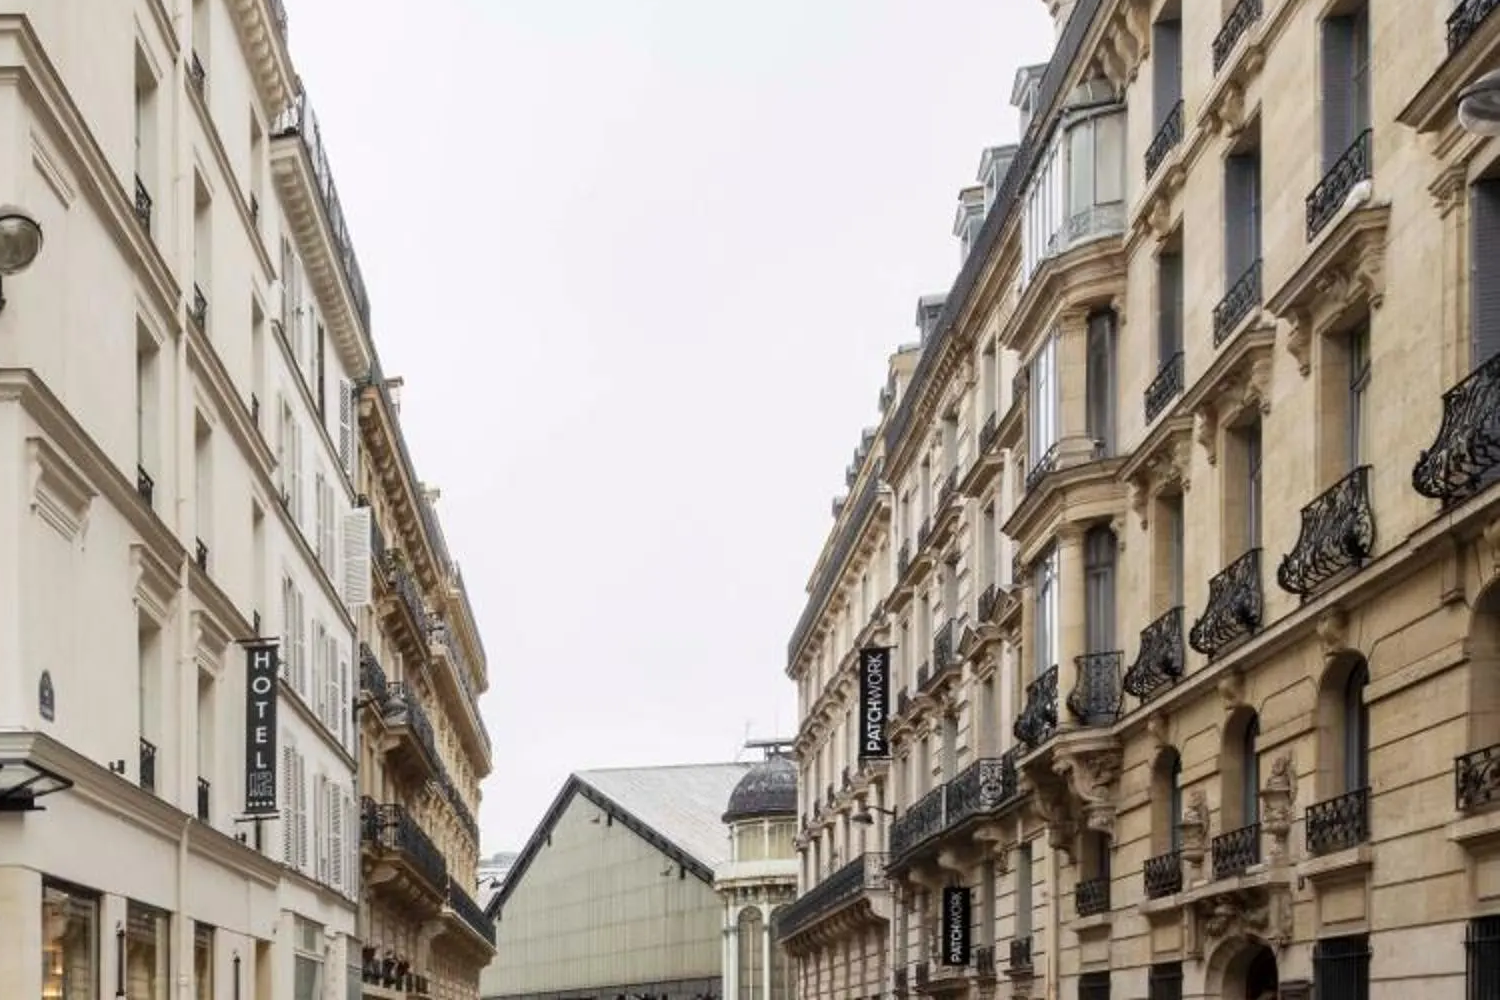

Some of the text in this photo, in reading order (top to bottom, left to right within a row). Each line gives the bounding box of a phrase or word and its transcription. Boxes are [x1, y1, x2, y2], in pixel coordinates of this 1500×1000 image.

[252, 651, 272, 769] HOTEL
[866, 652, 883, 752] PATCHWORK
[951, 891, 964, 963] PATCHWORK
